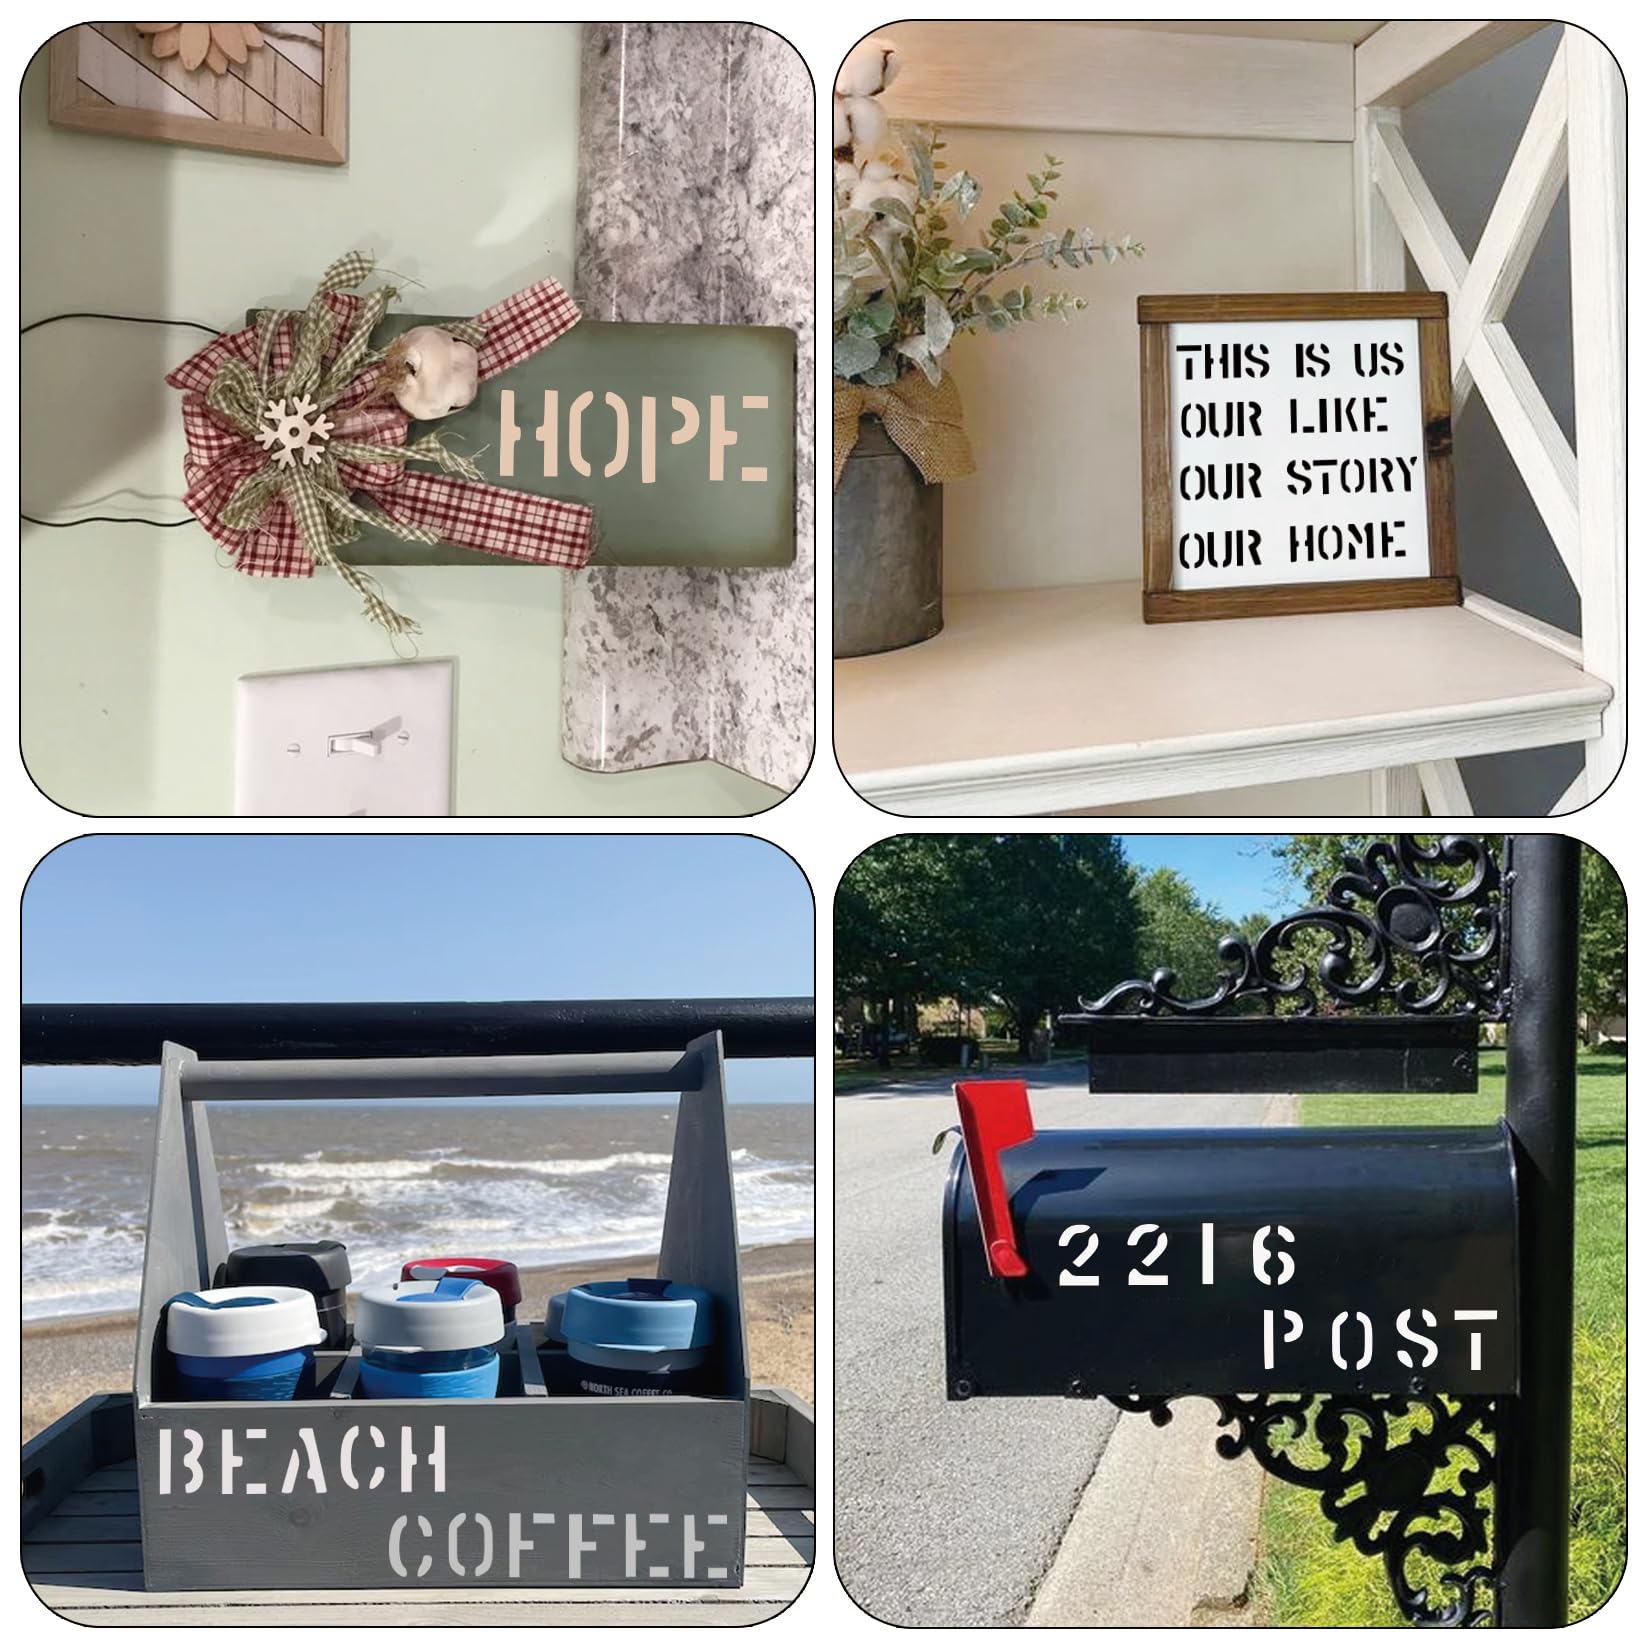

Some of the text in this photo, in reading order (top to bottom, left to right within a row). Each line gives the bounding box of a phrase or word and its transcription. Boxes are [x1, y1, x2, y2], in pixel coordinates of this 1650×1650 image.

[1176, 342, 1405, 380] THIS IS US
[500, 389, 769, 484] HOPE
[1180, 397, 1388, 438] OUR LIKE
[1179, 456, 1418, 500] OUR STORY
[1179, 521, 1407, 569] OUR HOME
[1059, 1222, 1295, 1287] 2216
[1263, 1308, 1498, 1371] POST
[159, 1425, 446, 1495] BEACH
[388, 1512, 728, 1579] COFFEE
